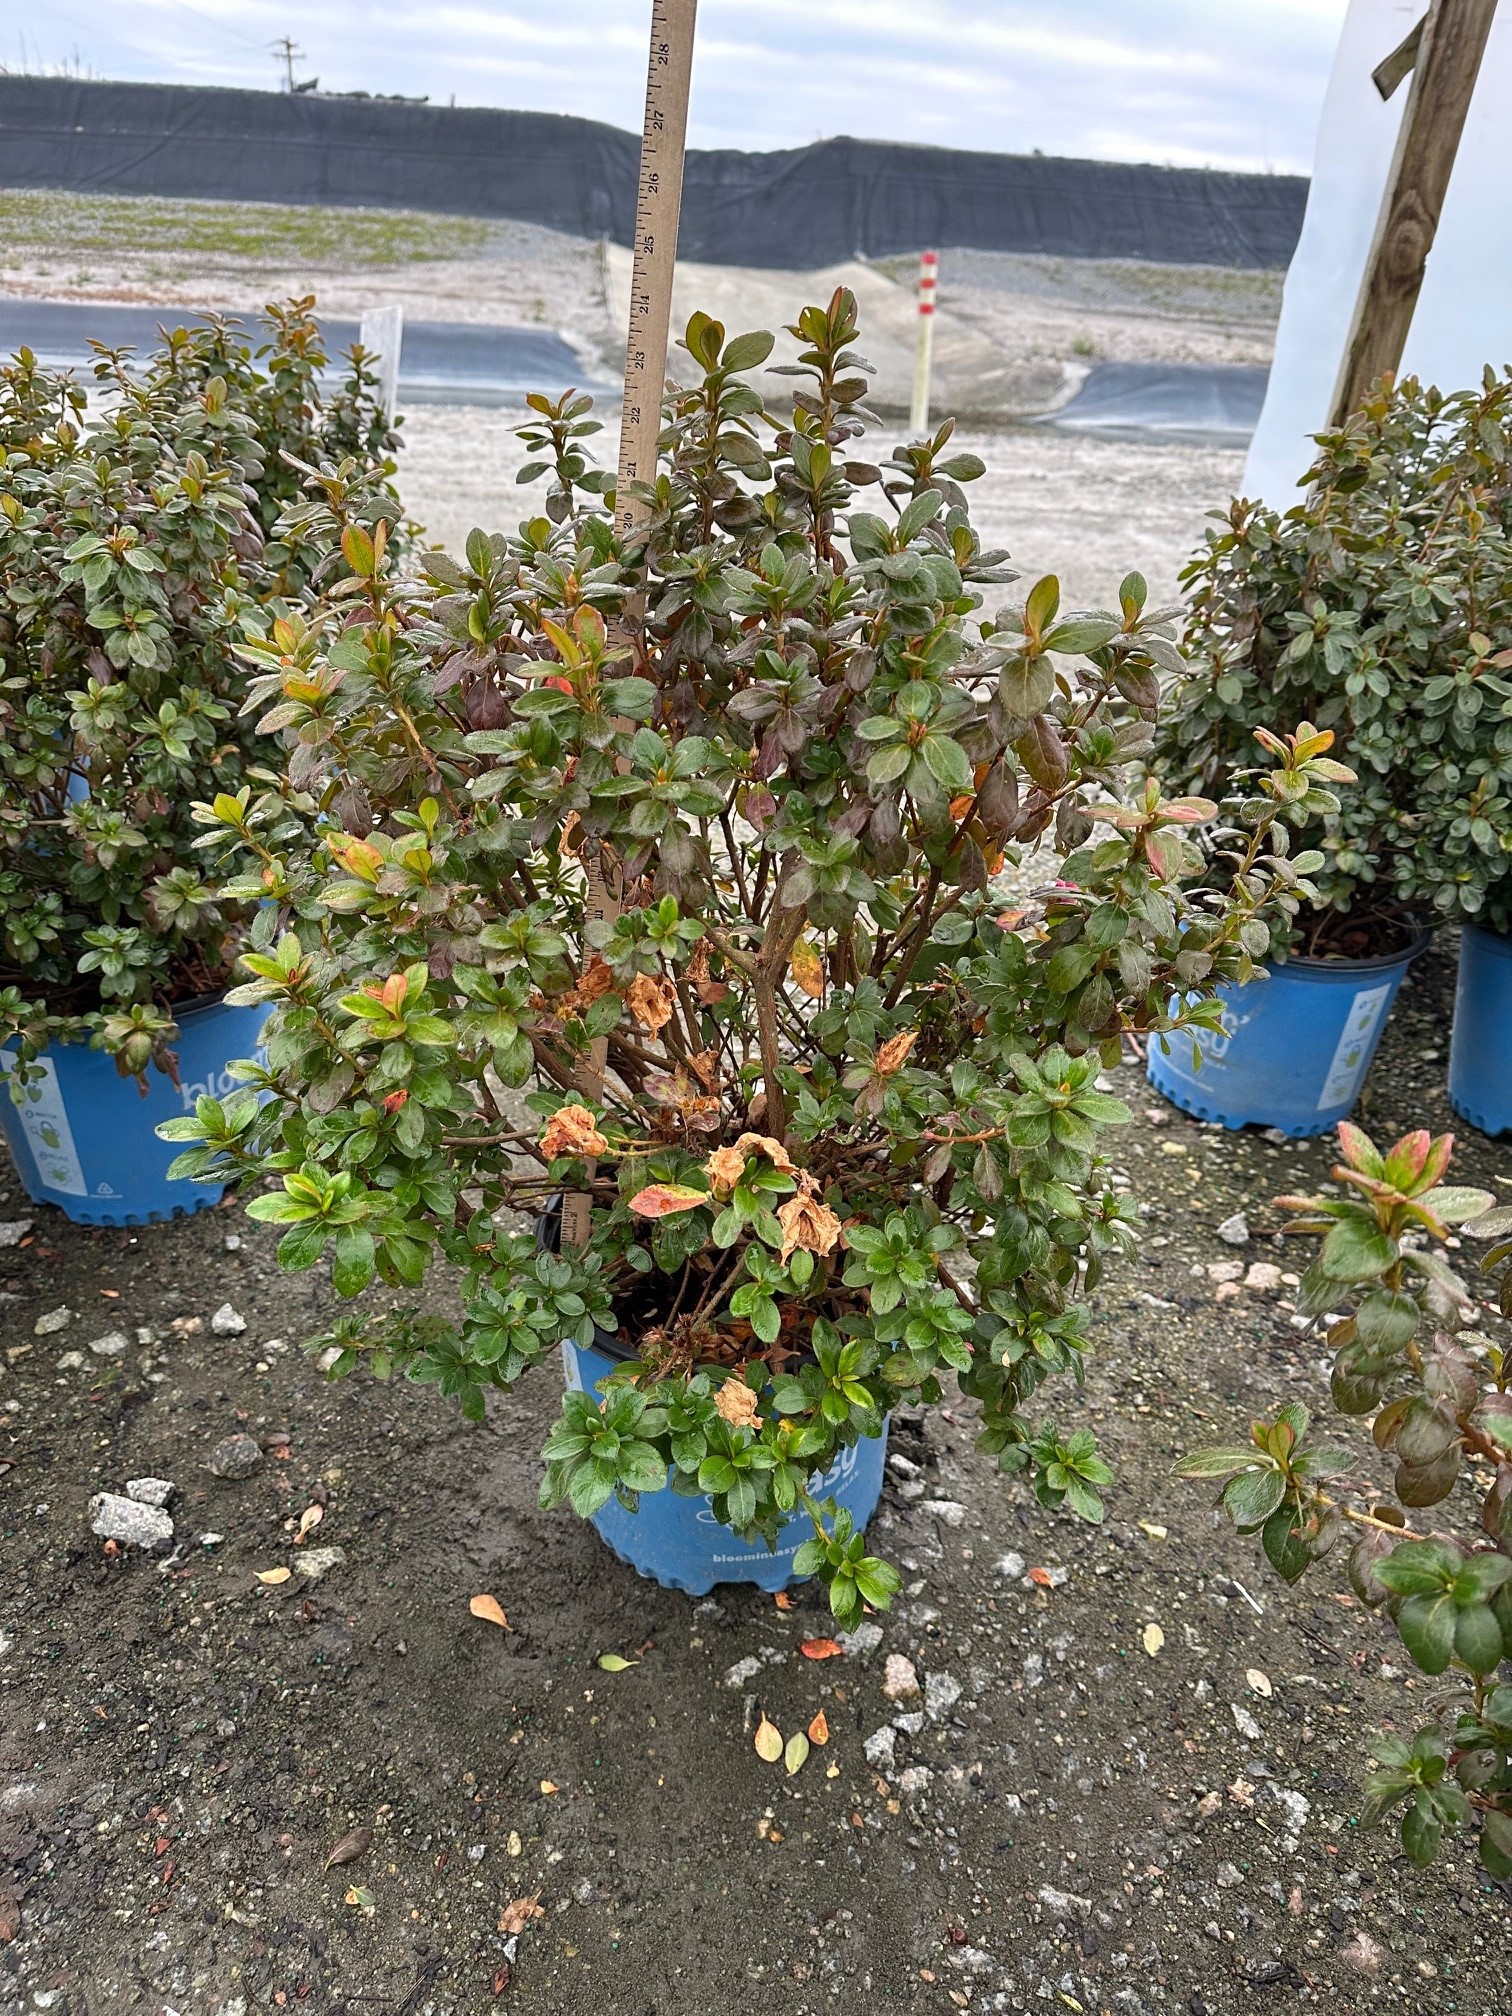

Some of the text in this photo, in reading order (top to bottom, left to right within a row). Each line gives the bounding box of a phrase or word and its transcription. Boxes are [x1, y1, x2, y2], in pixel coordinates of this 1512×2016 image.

[658, 43, 669, 65] 28
[653, 110, 664, 131] 27
[648, 172, 659, 194] 26
[644, 235, 655, 255] 25
[639, 294, 650, 314] 24
[634, 351, 645, 370] 23
[630, 406, 641, 425] 22
[626, 461, 637, 478] 21
[623, 512, 634, 529] 20
[595, 910, 603, 920] 11
